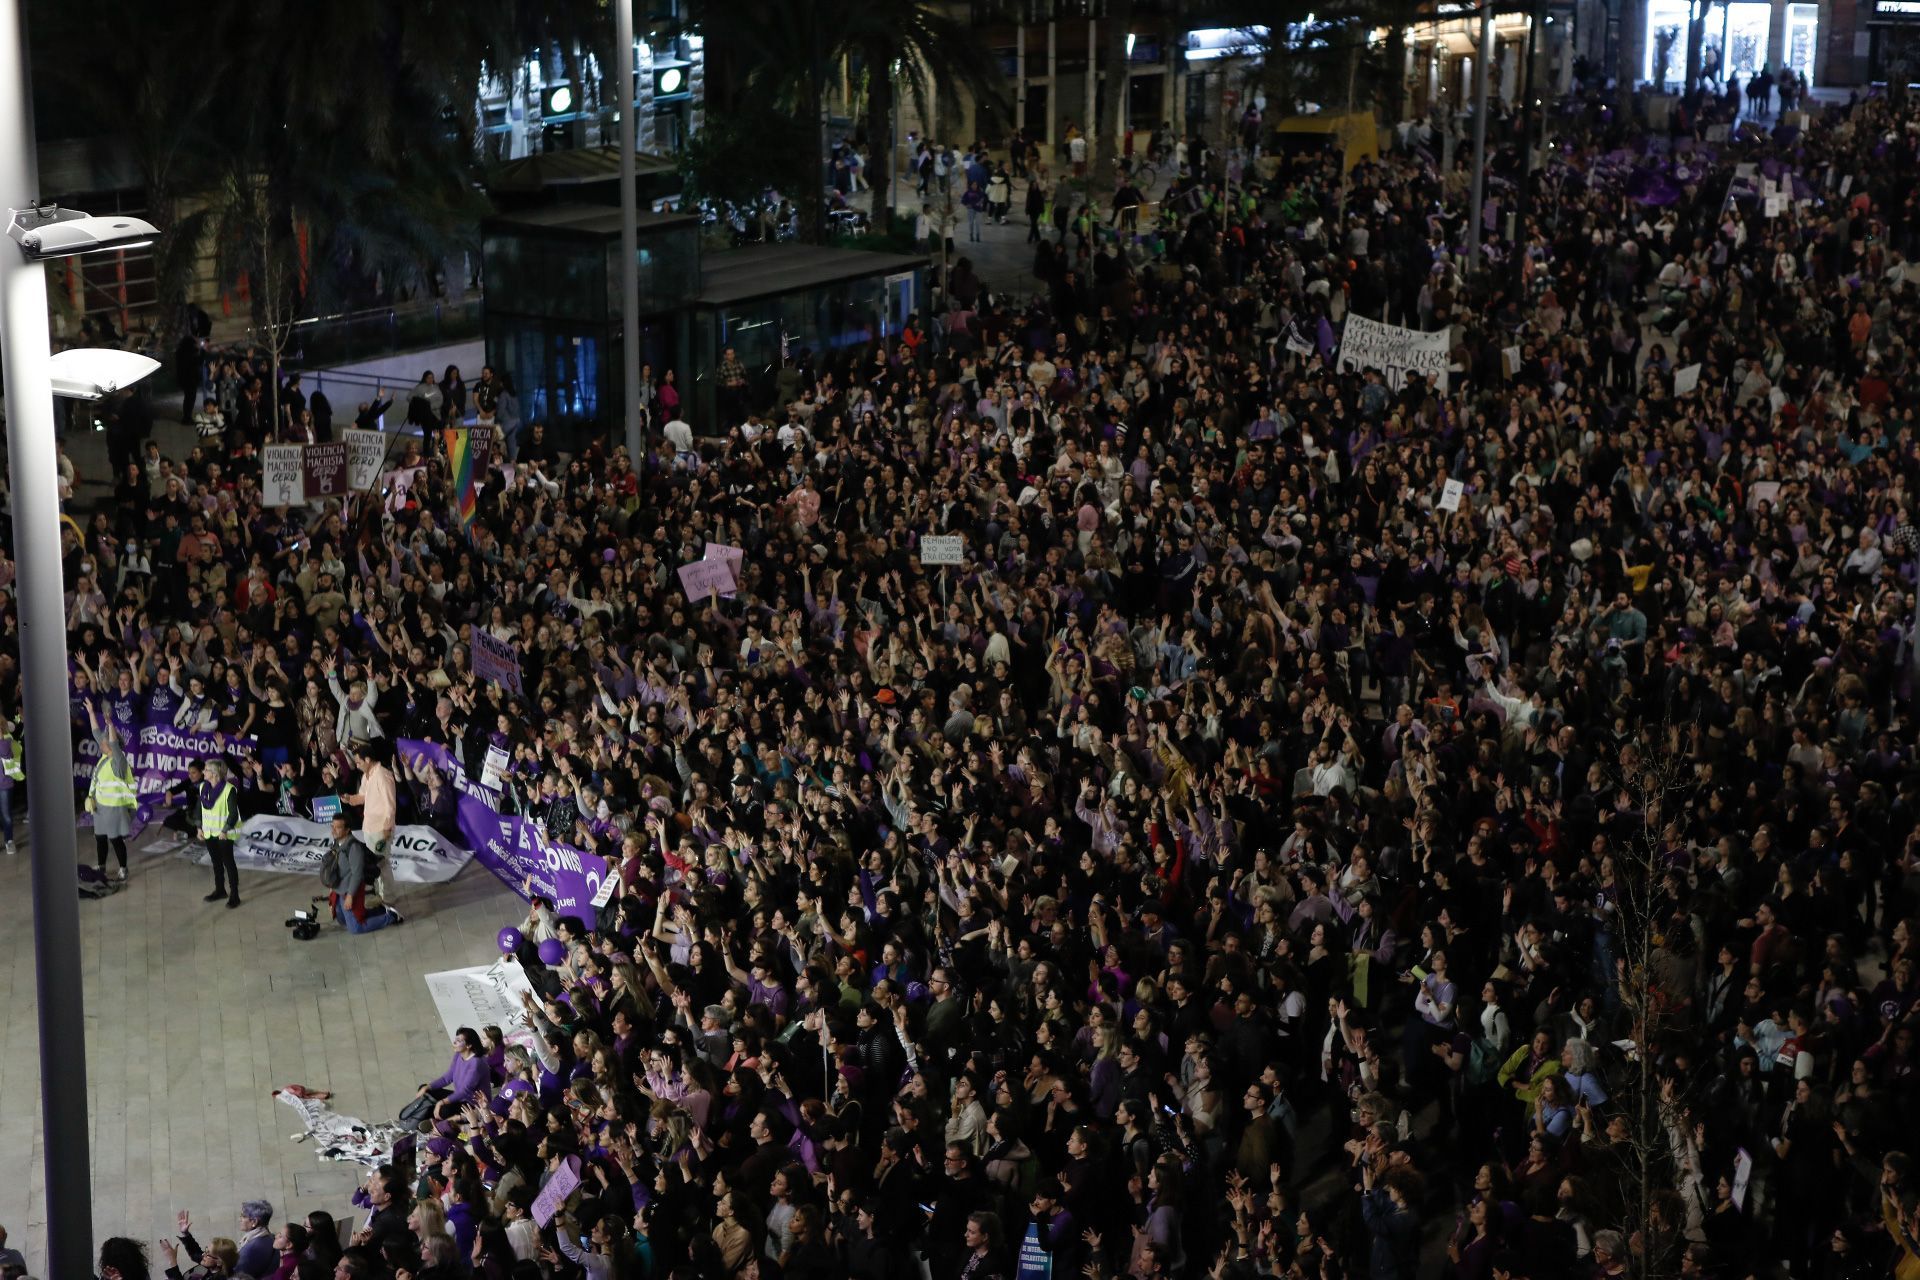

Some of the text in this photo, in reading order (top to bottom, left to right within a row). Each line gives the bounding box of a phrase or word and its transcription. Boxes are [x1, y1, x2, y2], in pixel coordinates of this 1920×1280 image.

[345, 432, 383, 445] VIOLENCIA
[306, 445, 345, 457] VIOLENCIA
[267, 460, 303, 473] MACHISTA
[307, 456, 344, 468] MACHISTA
[349, 456, 375, 466] CERO
[272, 472, 298, 483] CERO
[312, 466, 338, 478] CERO
[922, 537, 963, 545] FEMINISMO
[477, 632, 517, 665] FEMINISMO
[139, 732, 219, 755] ASOCIACIÓN
[136, 752, 155, 770] LA
